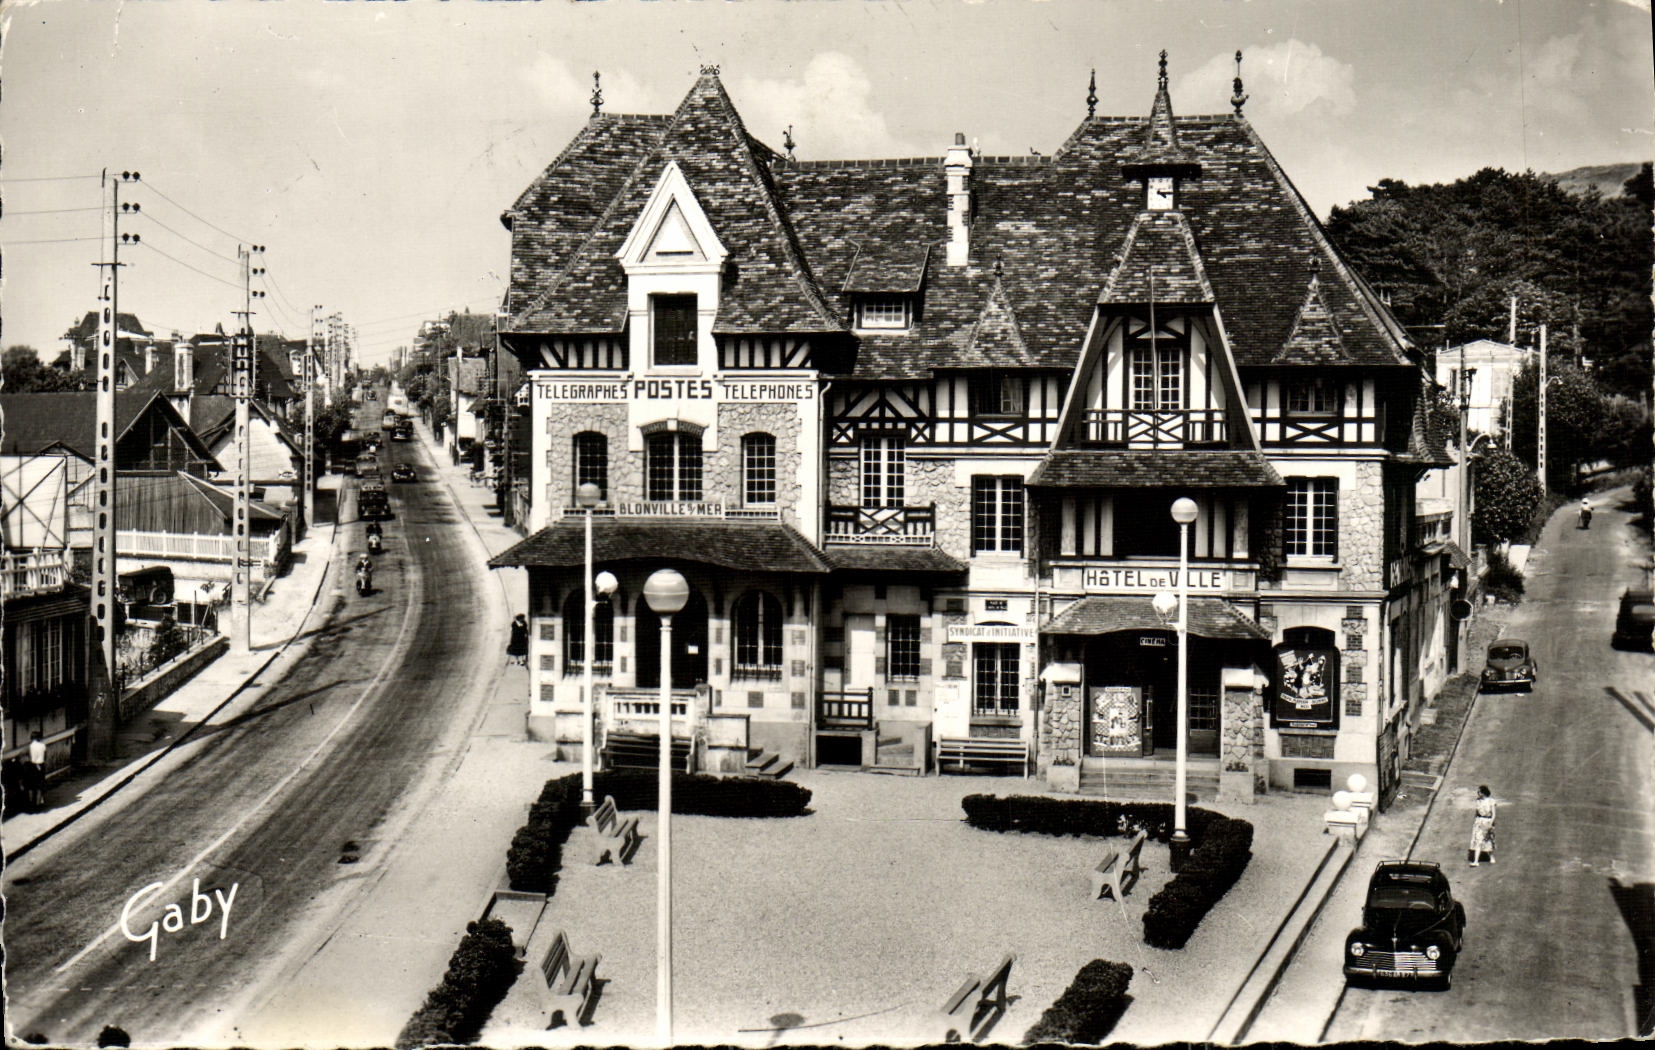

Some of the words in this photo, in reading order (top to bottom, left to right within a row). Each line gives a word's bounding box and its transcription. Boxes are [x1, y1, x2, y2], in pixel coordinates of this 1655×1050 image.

[537, 384, 628, 400] TELEGRAPHES
[634, 380, 713, 400] POSTES
[723, 384, 813, 400] TELEPHONES
[619, 502, 685, 516] BLONVILLE
[697, 502, 722, 516] MER
[1086, 569, 1147, 588] HÔTEL
[1169, 570, 1221, 588] VLLE
[949, 626, 985, 638] SYNDICAT
